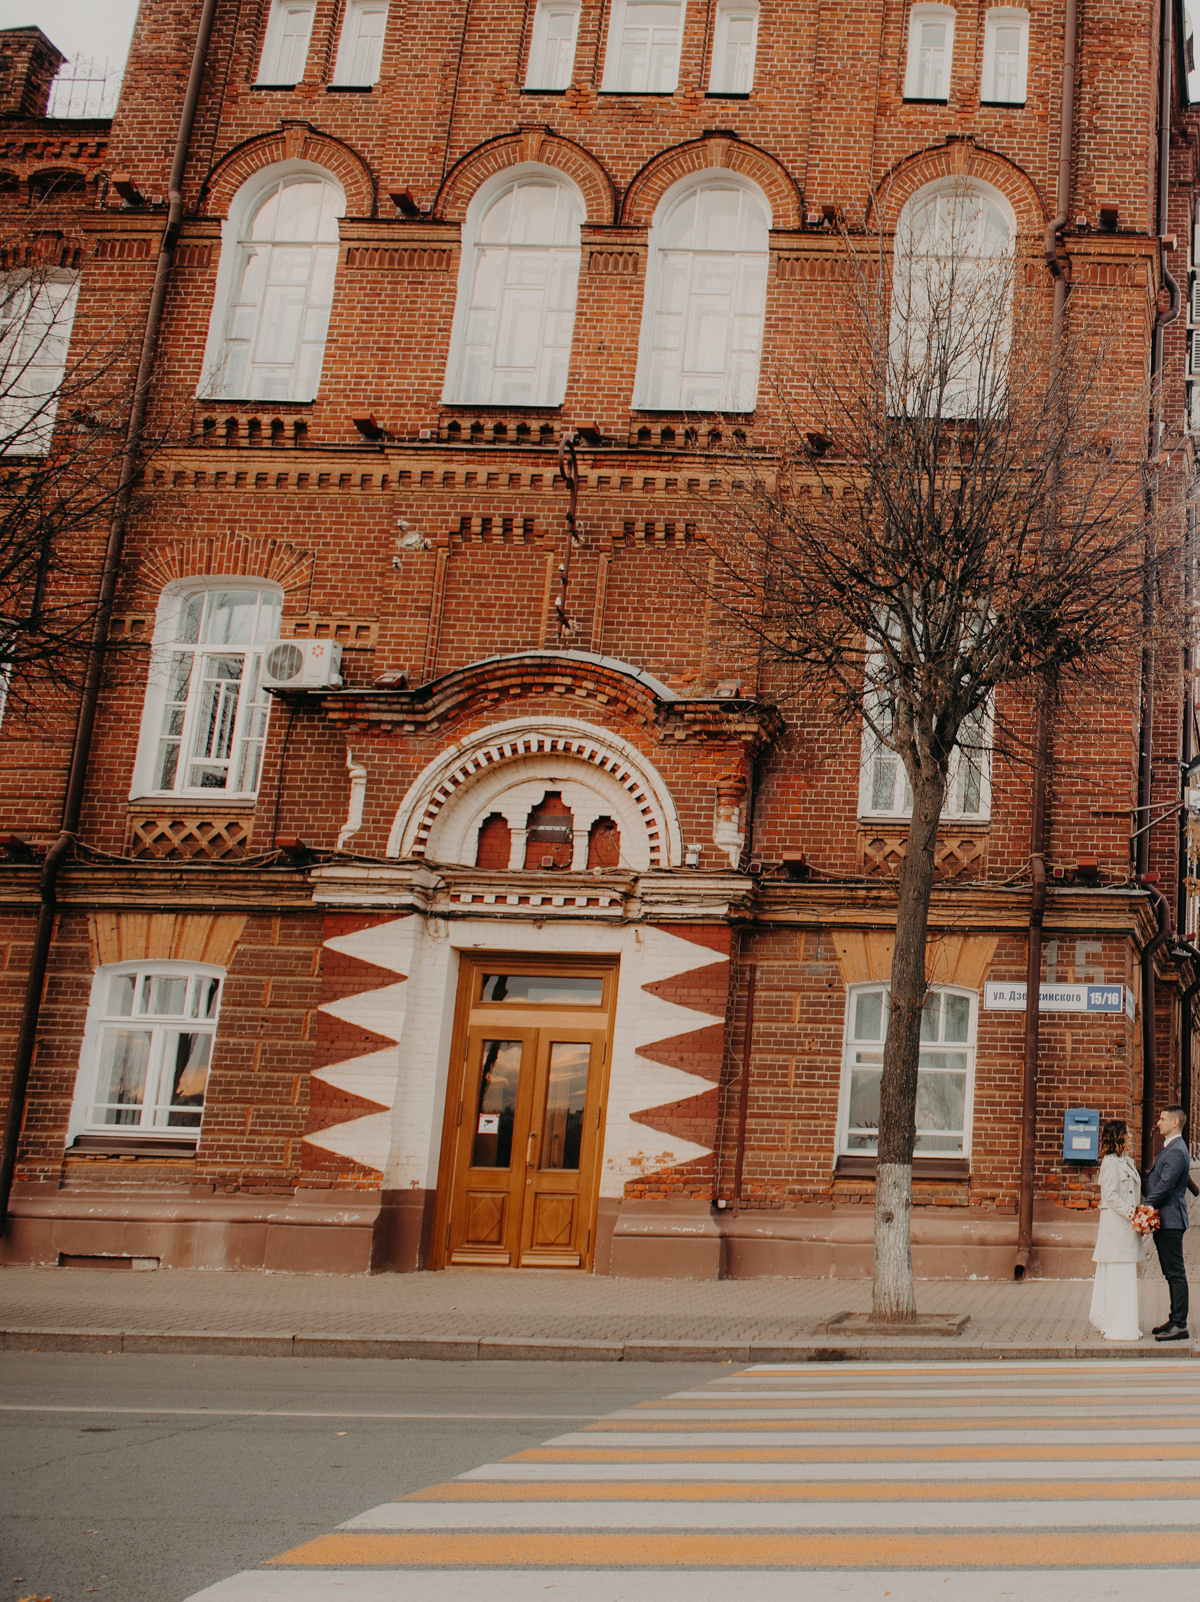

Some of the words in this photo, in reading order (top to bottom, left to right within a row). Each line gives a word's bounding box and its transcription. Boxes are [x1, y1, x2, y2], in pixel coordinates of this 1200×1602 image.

[993, 991, 1007, 1001] ул.
[1008, 990, 1082, 1003] Дзеинского
[1089, 991, 1120, 1006] 15/16
